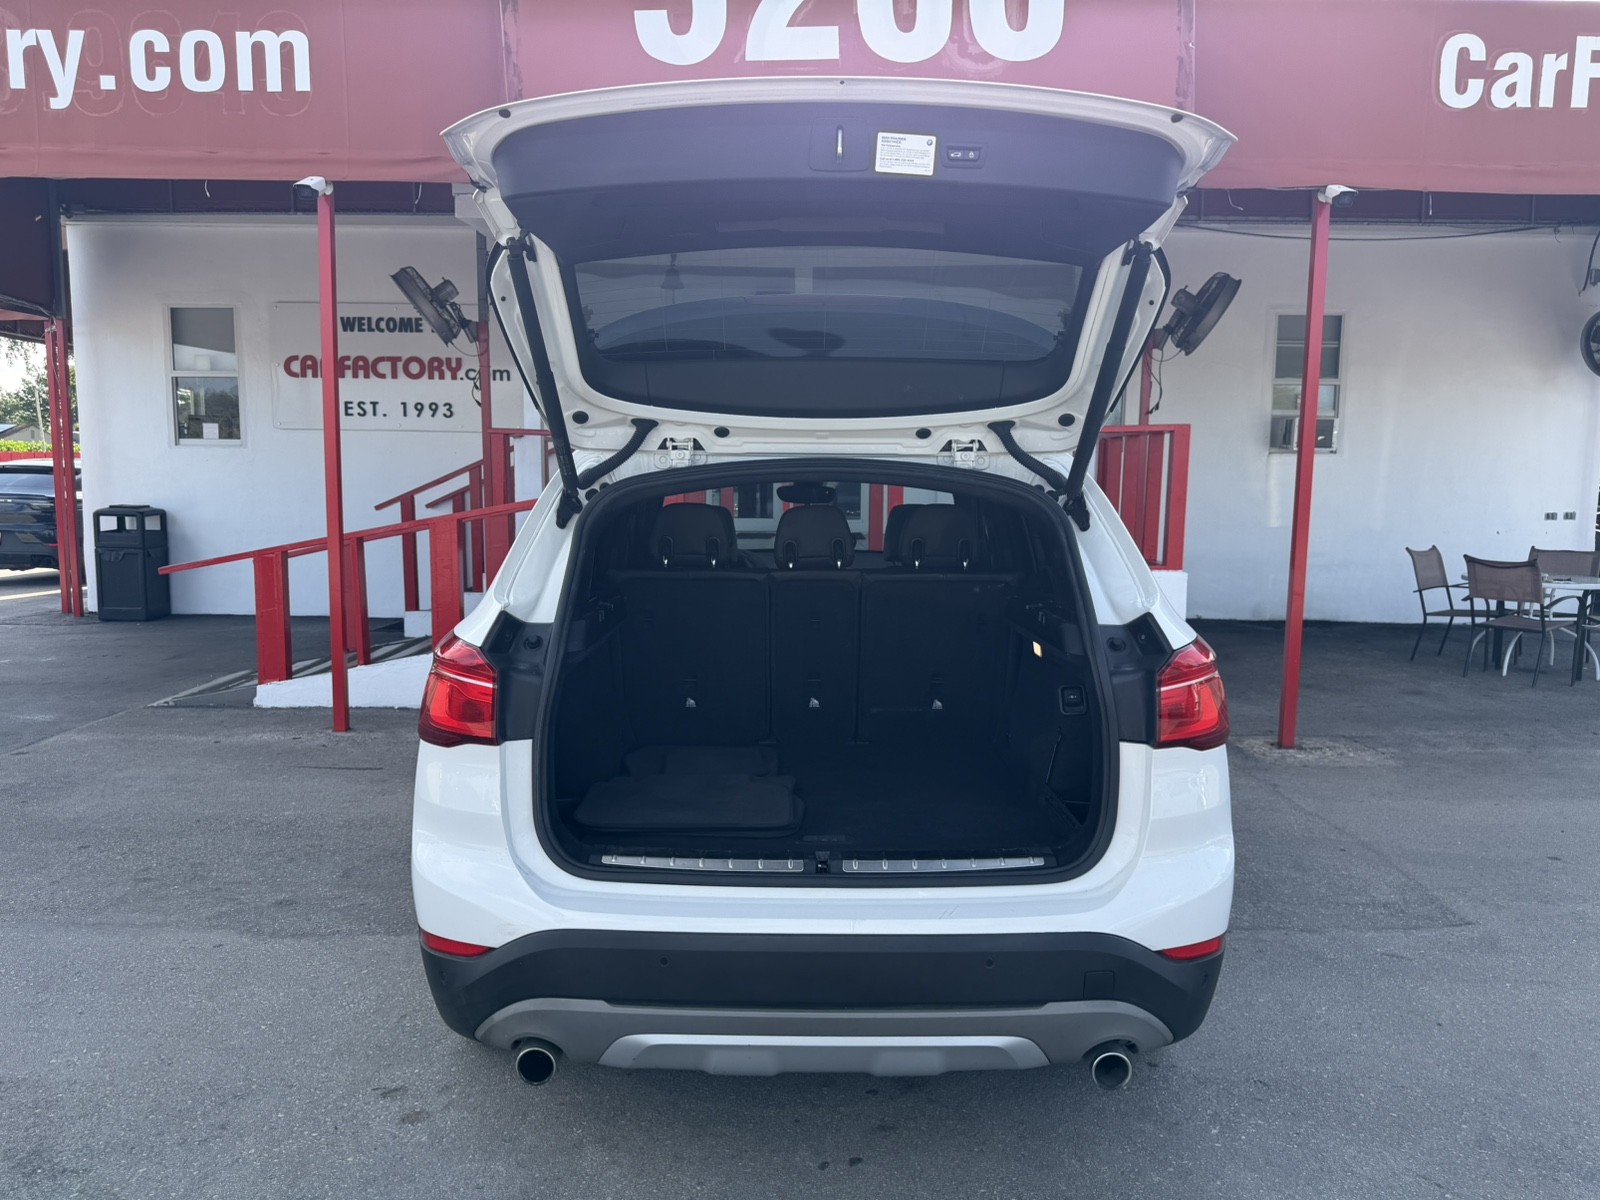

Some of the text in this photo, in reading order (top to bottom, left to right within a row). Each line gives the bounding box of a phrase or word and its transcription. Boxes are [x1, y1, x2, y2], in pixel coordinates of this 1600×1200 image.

[5, 28, 311, 110] ry.com
[340, 316, 424, 334] WELCOME
[283, 354, 511, 382] CAFACTORY.cm
[344, 401, 454, 418] EST. 1993
